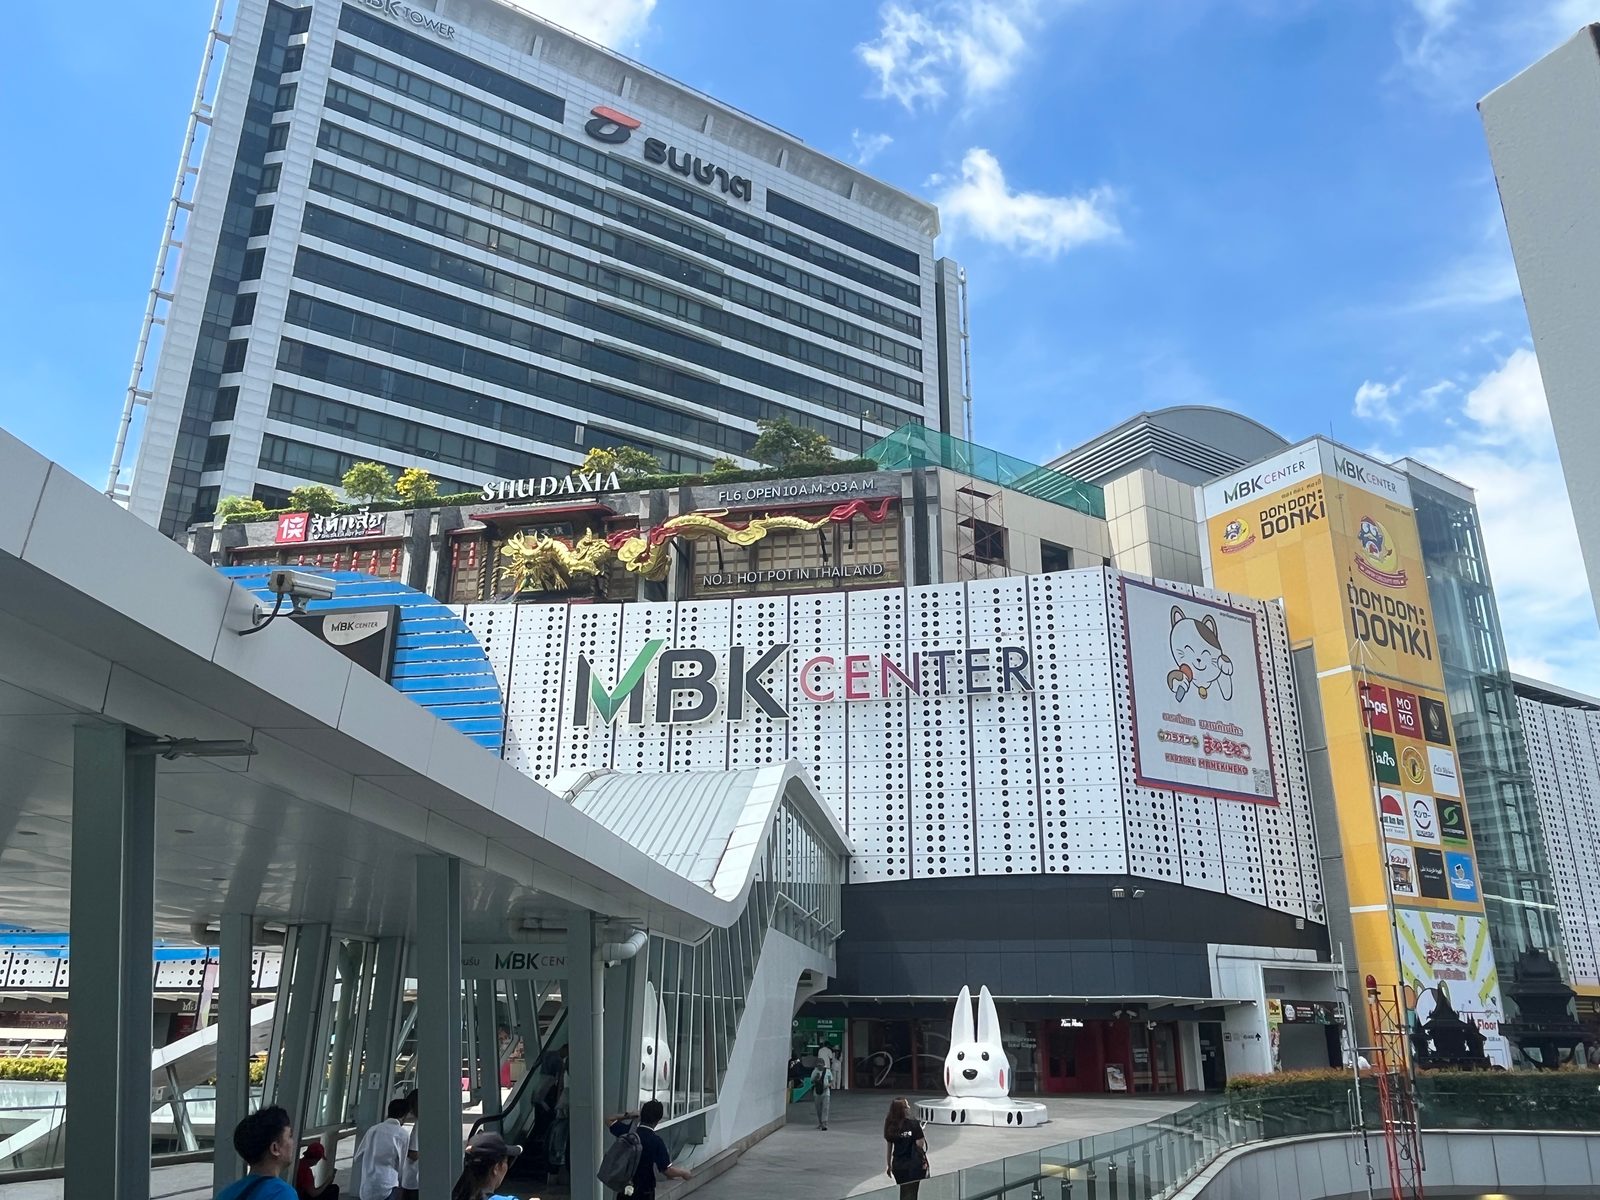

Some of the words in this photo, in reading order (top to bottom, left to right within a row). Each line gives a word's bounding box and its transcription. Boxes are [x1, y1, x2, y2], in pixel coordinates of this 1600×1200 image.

[358, 0, 402, 18] BK
[403, 6, 456, 39] TOWER
[643, 136, 753, 202] ธนชาต
[1223, 475, 1264, 504] MBK
[1264, 460, 1306, 485] CENTER
[1334, 456, 1367, 484] MBK
[1366, 473, 1397, 494] CENTER
[746, 487, 781, 500] OPEN
[1259, 503, 1287, 522] DON
[1288, 492, 1316, 511] DON
[1261, 500, 1325, 540] DONKI
[737, 571, 763, 584] HOT
[767, 569, 793, 582] POT
[796, 567, 809, 580] IN
[814, 563, 883, 579] THAILAND
[1384, 596, 1419, 624] DON
[331, 621, 355, 632] MBK
[355, 621, 378, 629] CENTER
[1350, 607, 1432, 661] DONKI
[572, 638, 791, 727] MBK
[799, 646, 1036, 703] CENTER
[1396, 697, 1412, 711] MO
[1398, 712, 1414, 727] MO
[494, 951, 540, 970] MBK
[541, 956, 568, 967] CEN
